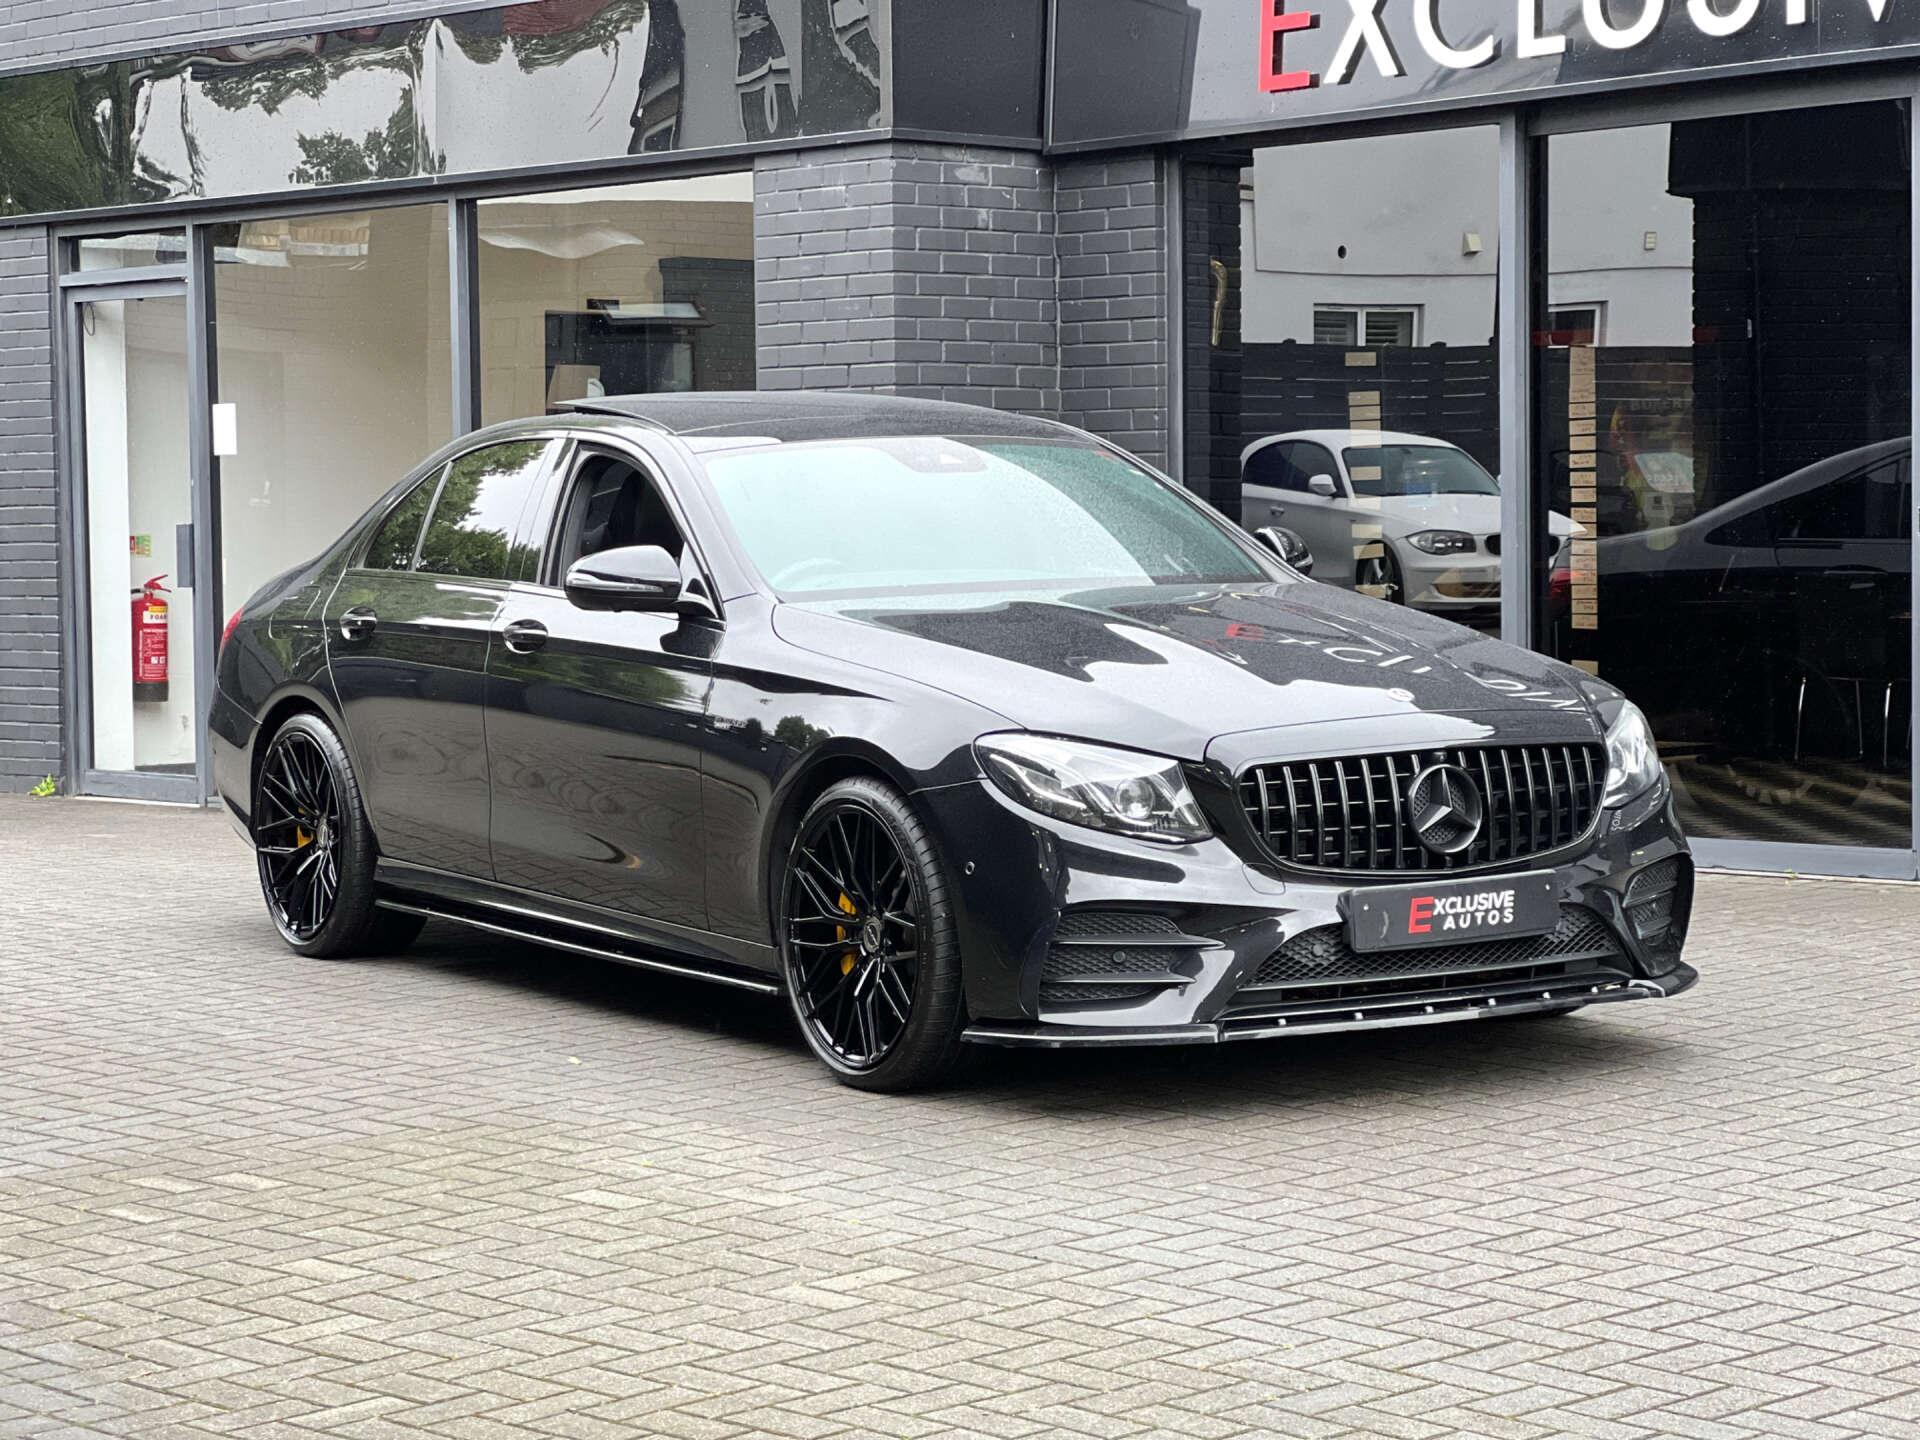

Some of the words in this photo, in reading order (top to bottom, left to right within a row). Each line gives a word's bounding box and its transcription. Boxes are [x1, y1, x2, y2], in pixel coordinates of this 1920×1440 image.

[1258, 0, 1893, 92] EXCL
[1408, 891, 1515, 933] EXCLUSIVE
[1443, 909, 1514, 931] AUTOS
